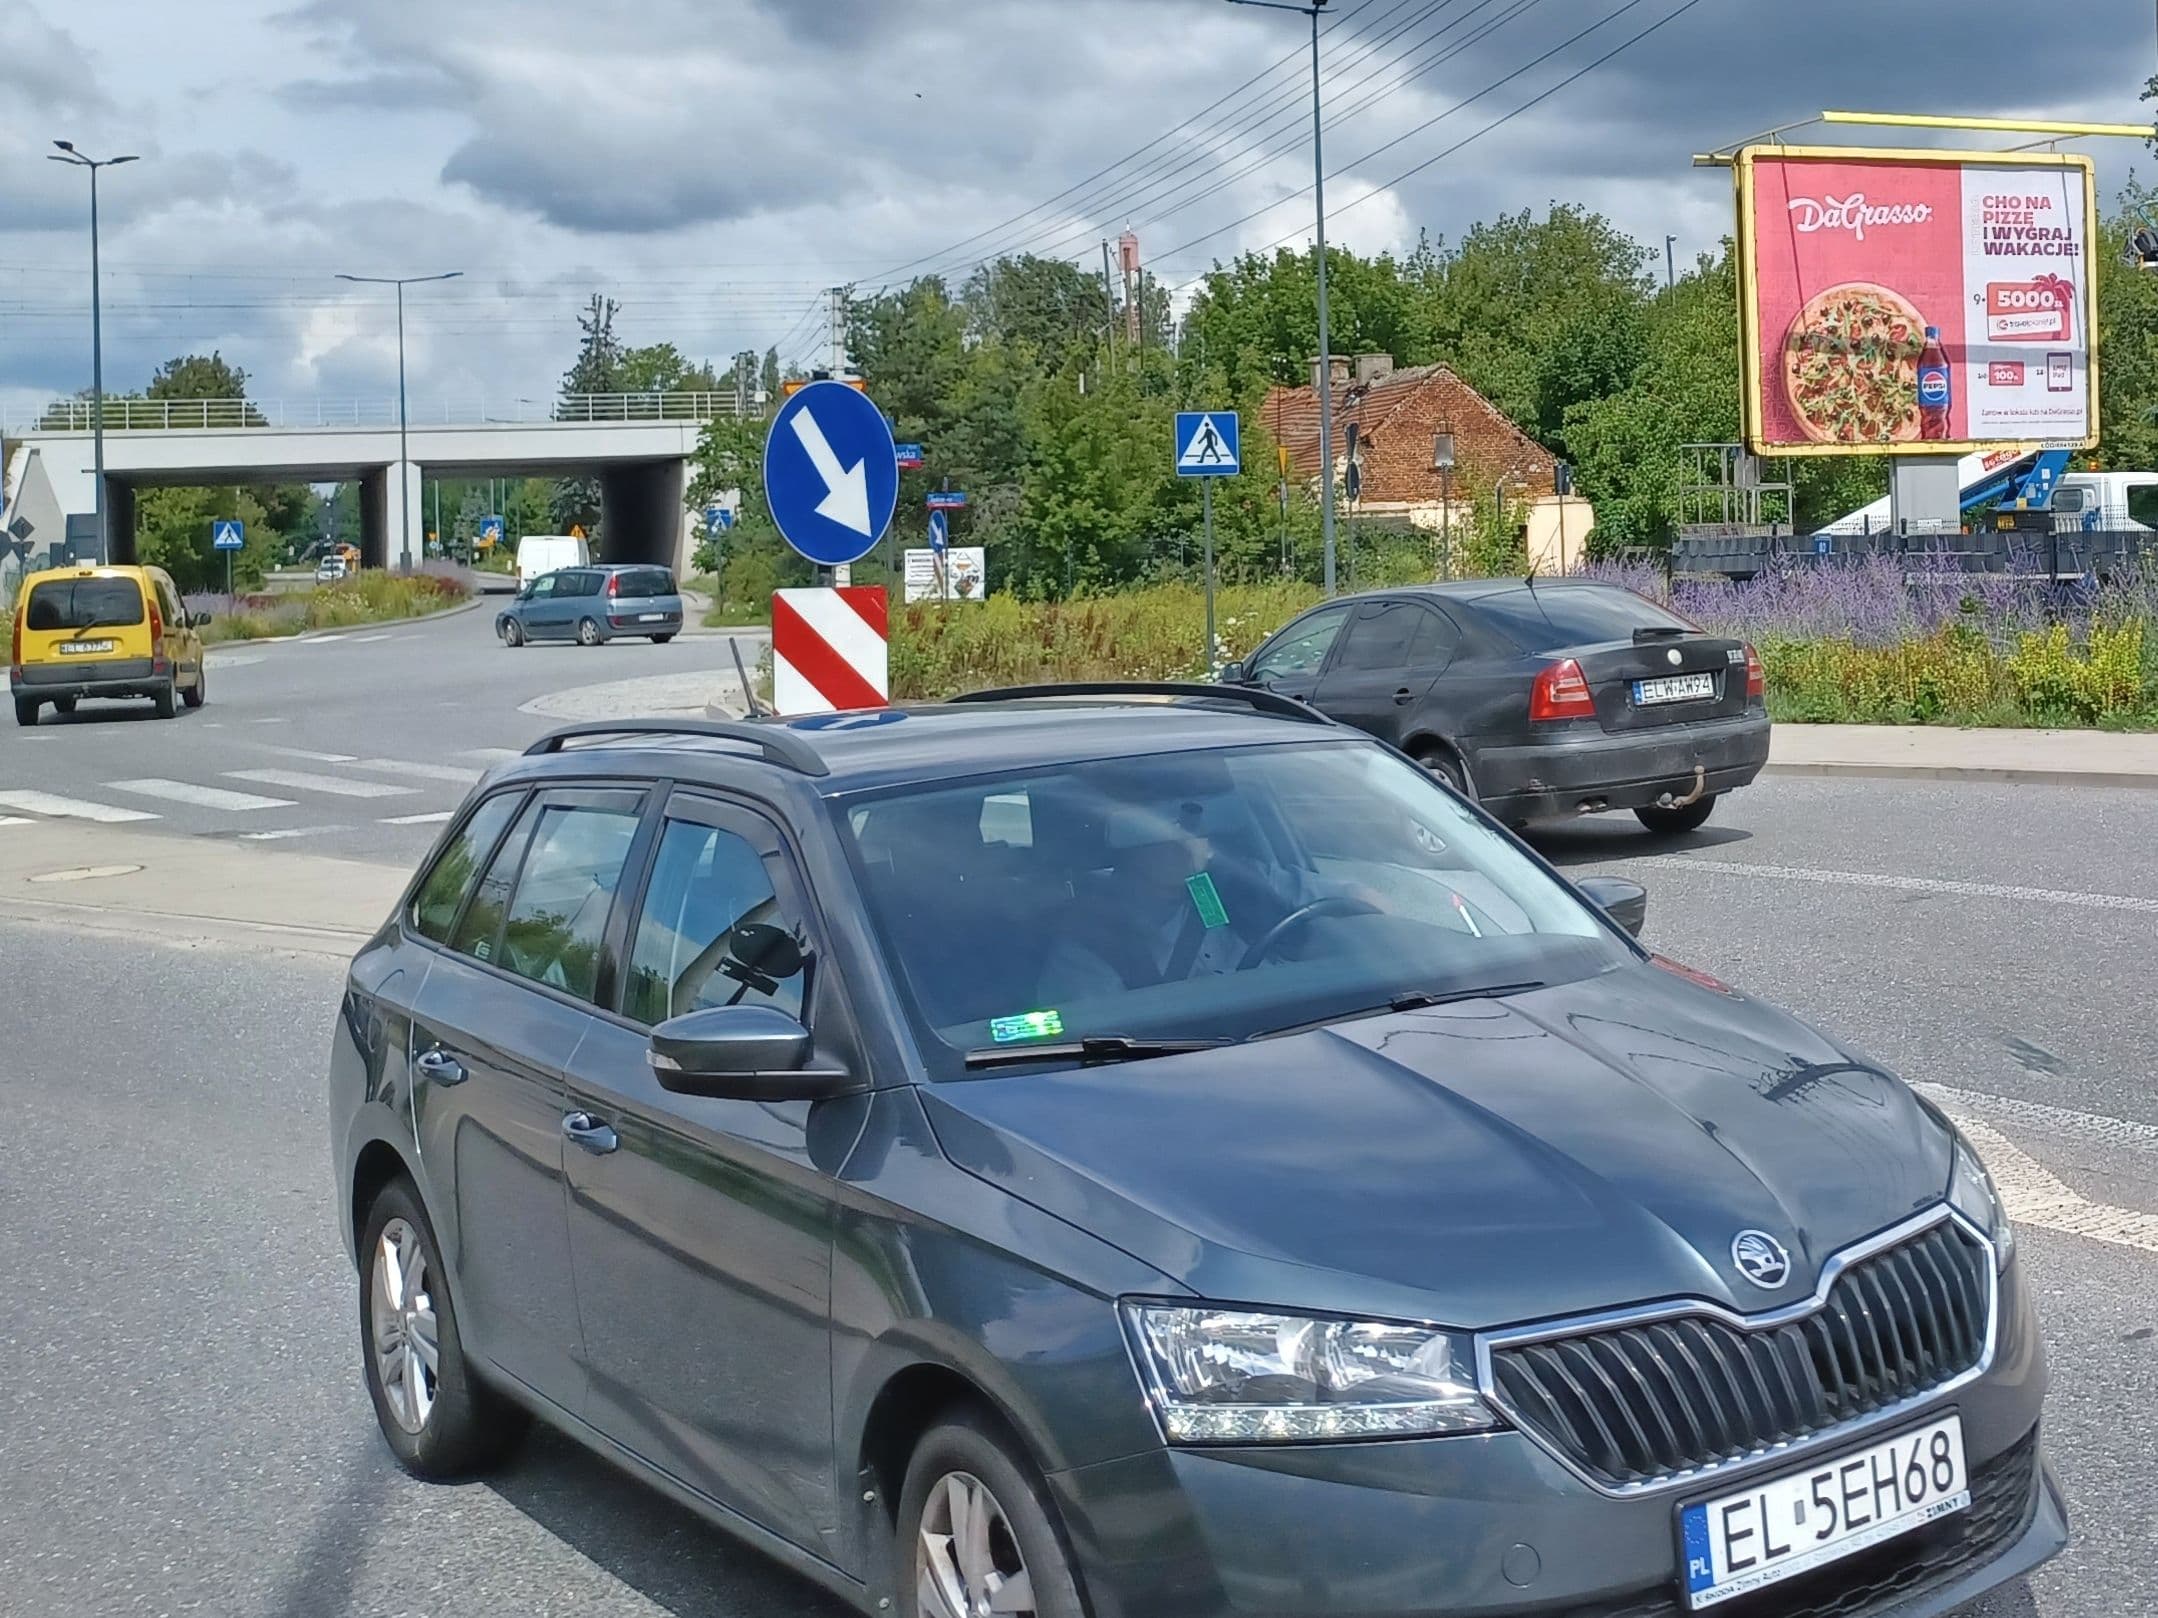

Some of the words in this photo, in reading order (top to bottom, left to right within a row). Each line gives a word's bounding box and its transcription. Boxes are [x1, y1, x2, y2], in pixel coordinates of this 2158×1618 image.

[1982, 195, 2021, 209] CHO
[2025, 196, 2052, 210] NA
[1789, 193, 1932, 241] DaGrasso
[1983, 211, 2034, 228] PIZZĘ
[1983, 226, 1988, 240] I
[1991, 226, 2072, 241] WYGRAJ
[1983, 241, 2079, 256] WAKACJE!
[1642, 679, 1674, 699] ELW
[1678, 676, 1711, 696] AW94
[1722, 1494, 1791, 1573] EL
[1811, 1430, 1954, 1540] 5EH68
[1689, 1556, 1711, 1579] PL
